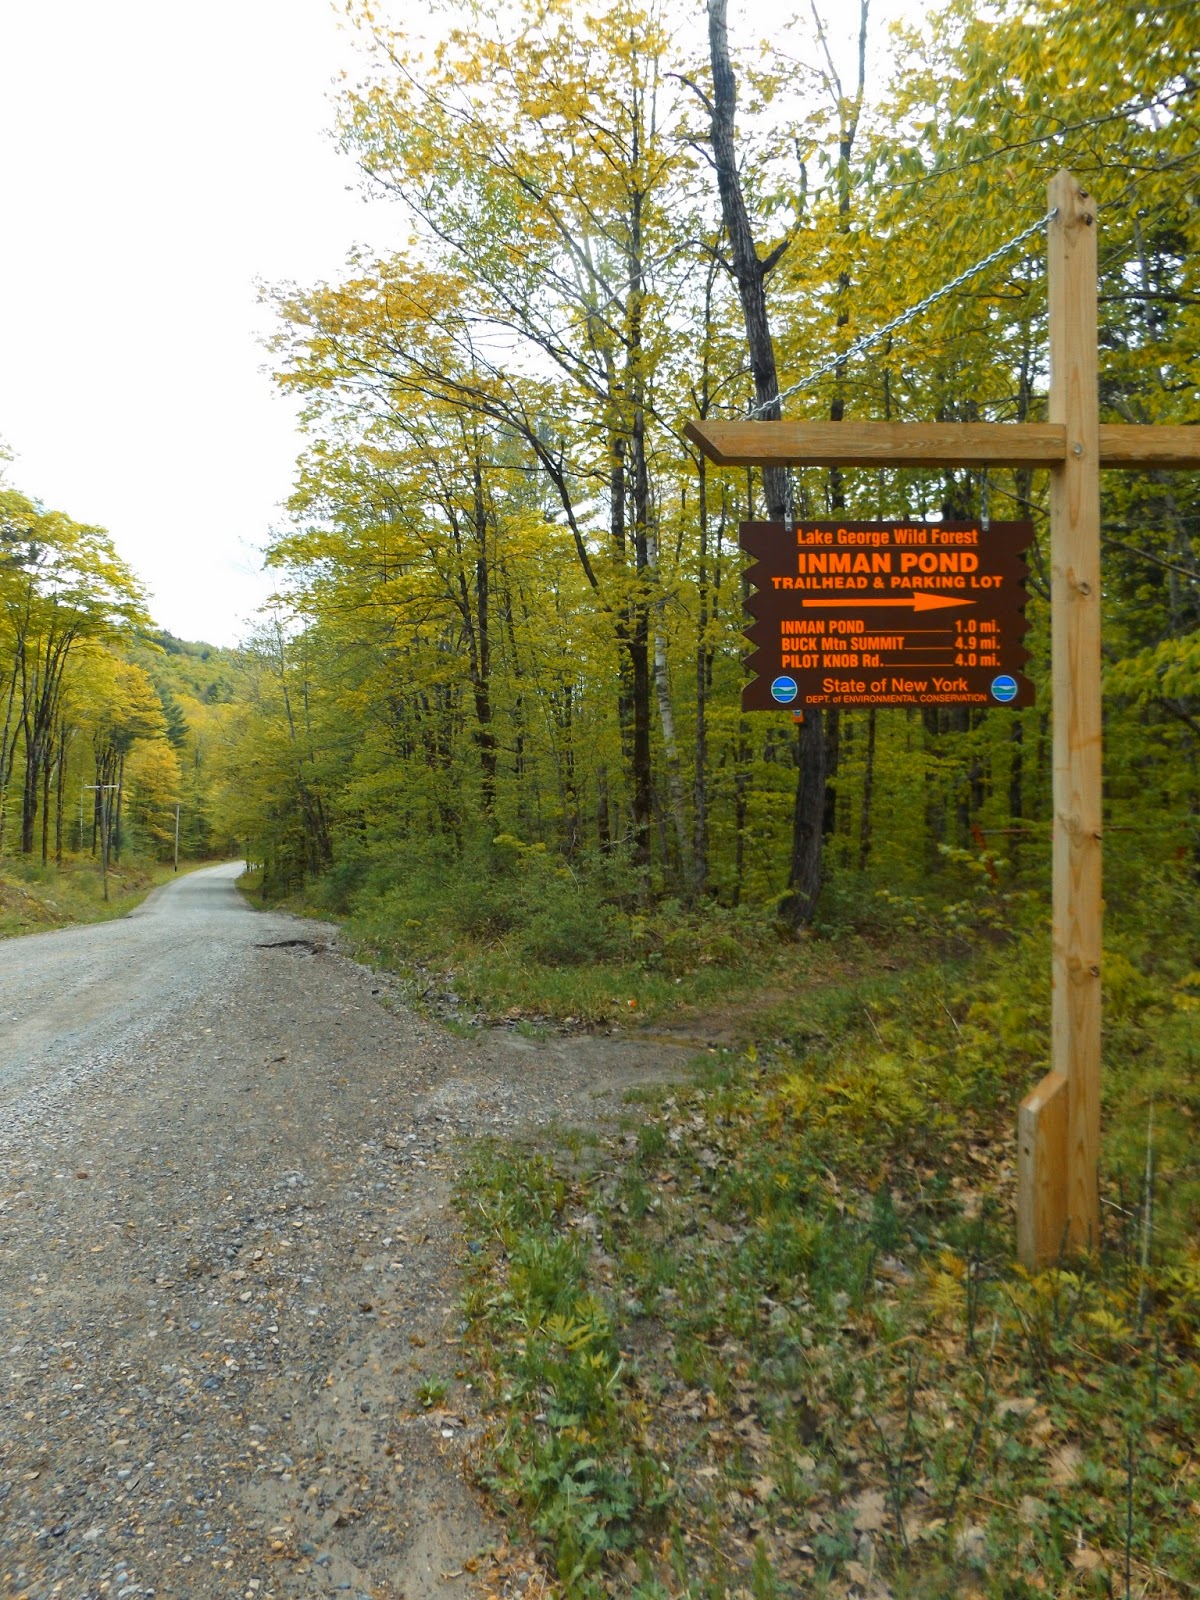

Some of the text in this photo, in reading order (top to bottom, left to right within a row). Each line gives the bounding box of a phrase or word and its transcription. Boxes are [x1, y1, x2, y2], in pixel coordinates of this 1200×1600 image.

[797, 528, 978, 547] Lake George Wild Forest
[799, 552, 979, 573] INMAN POND
[772, 576, 1003, 589] TRAILHEAD & PARKING LOT
[781, 620, 1000, 634] INMAN POND 1.0 mi.
[781, 637, 1000, 651] BUCK Mtn SUMMIT 4.9 mi.
[782, 654, 1000, 668] PILOT KNOB Rd. 4.0 mi.
[823, 678, 968, 693] State of New York
[844, 695, 917, 703] ENVIRONMENTAL
[920, 694, 987, 702] CONSERVATION
